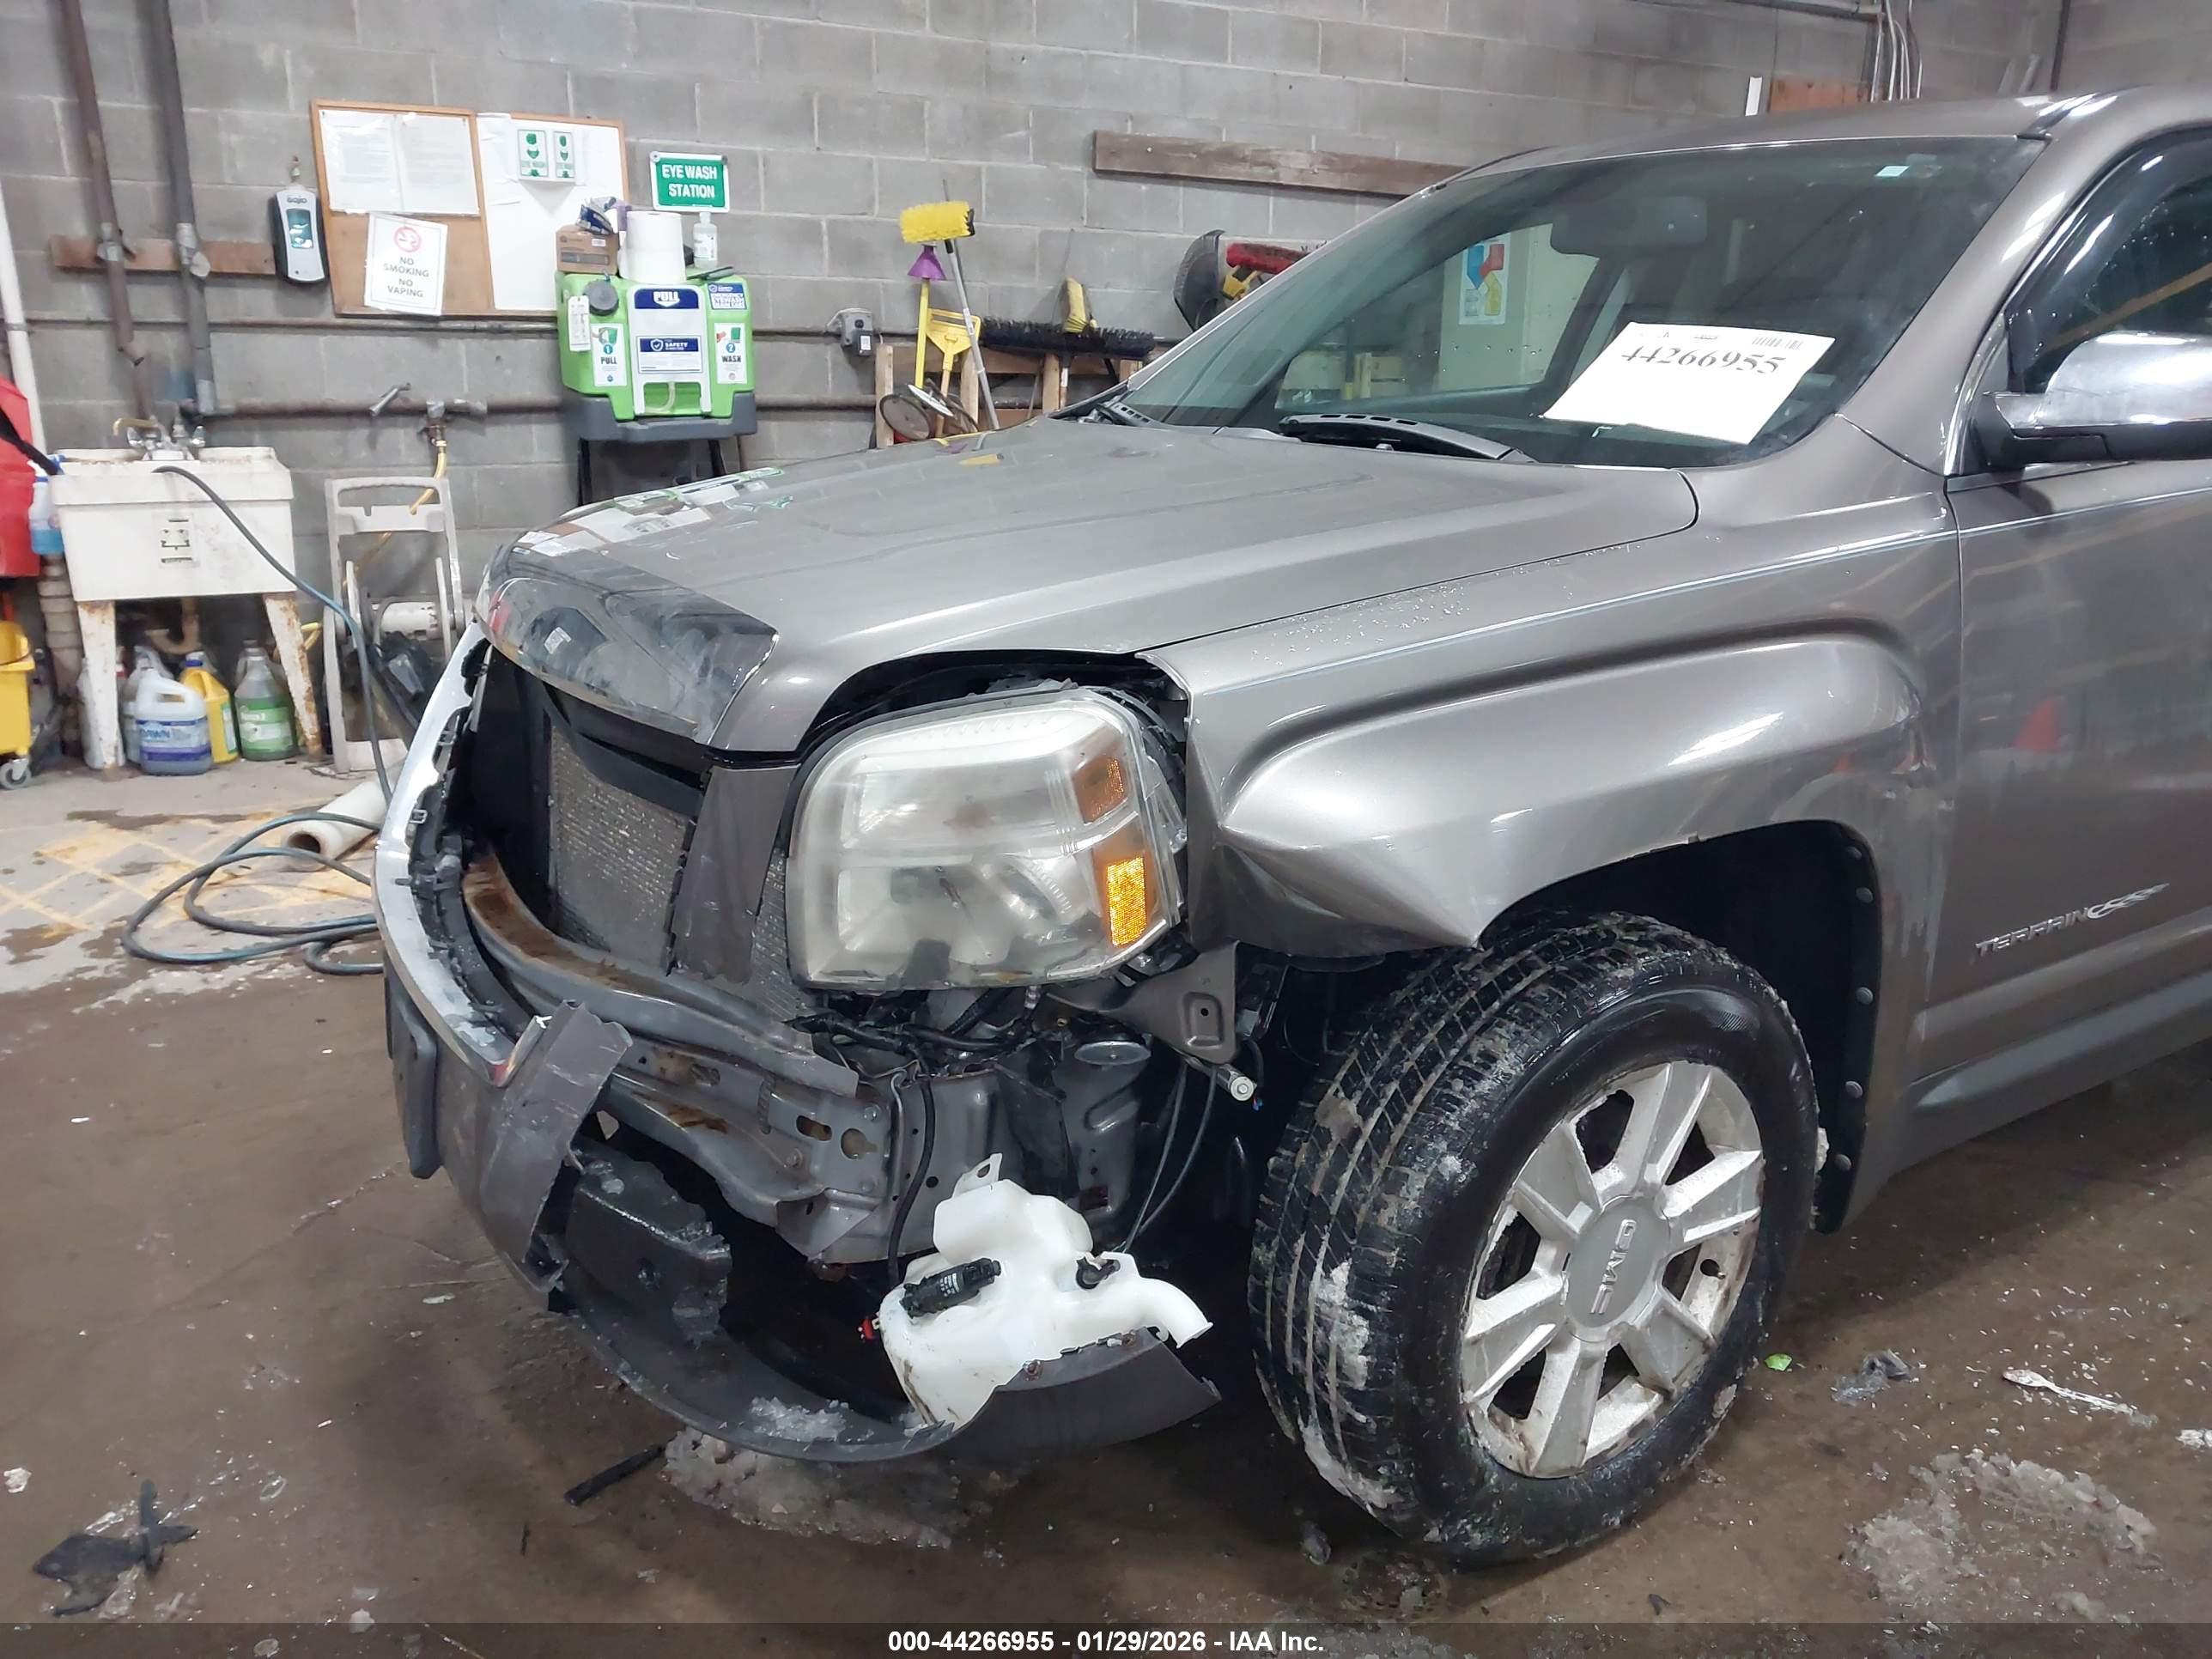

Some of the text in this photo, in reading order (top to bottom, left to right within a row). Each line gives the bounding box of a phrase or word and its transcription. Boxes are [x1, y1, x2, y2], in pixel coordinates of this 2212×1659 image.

[661, 164, 718, 179] EYE WASH
[668, 183, 715, 198] STATION
[399, 257, 414, 266] NO
[383, 263, 429, 277] SMOKING
[398, 278, 413, 287] NO
[387, 285, 423, 297] VAPING
[653, 291, 679, 301] PULL
[600, 356, 617, 365] PULL
[1621, 345, 1786, 374] 44266955
[1590, 1218, 1637, 1315] GMC
